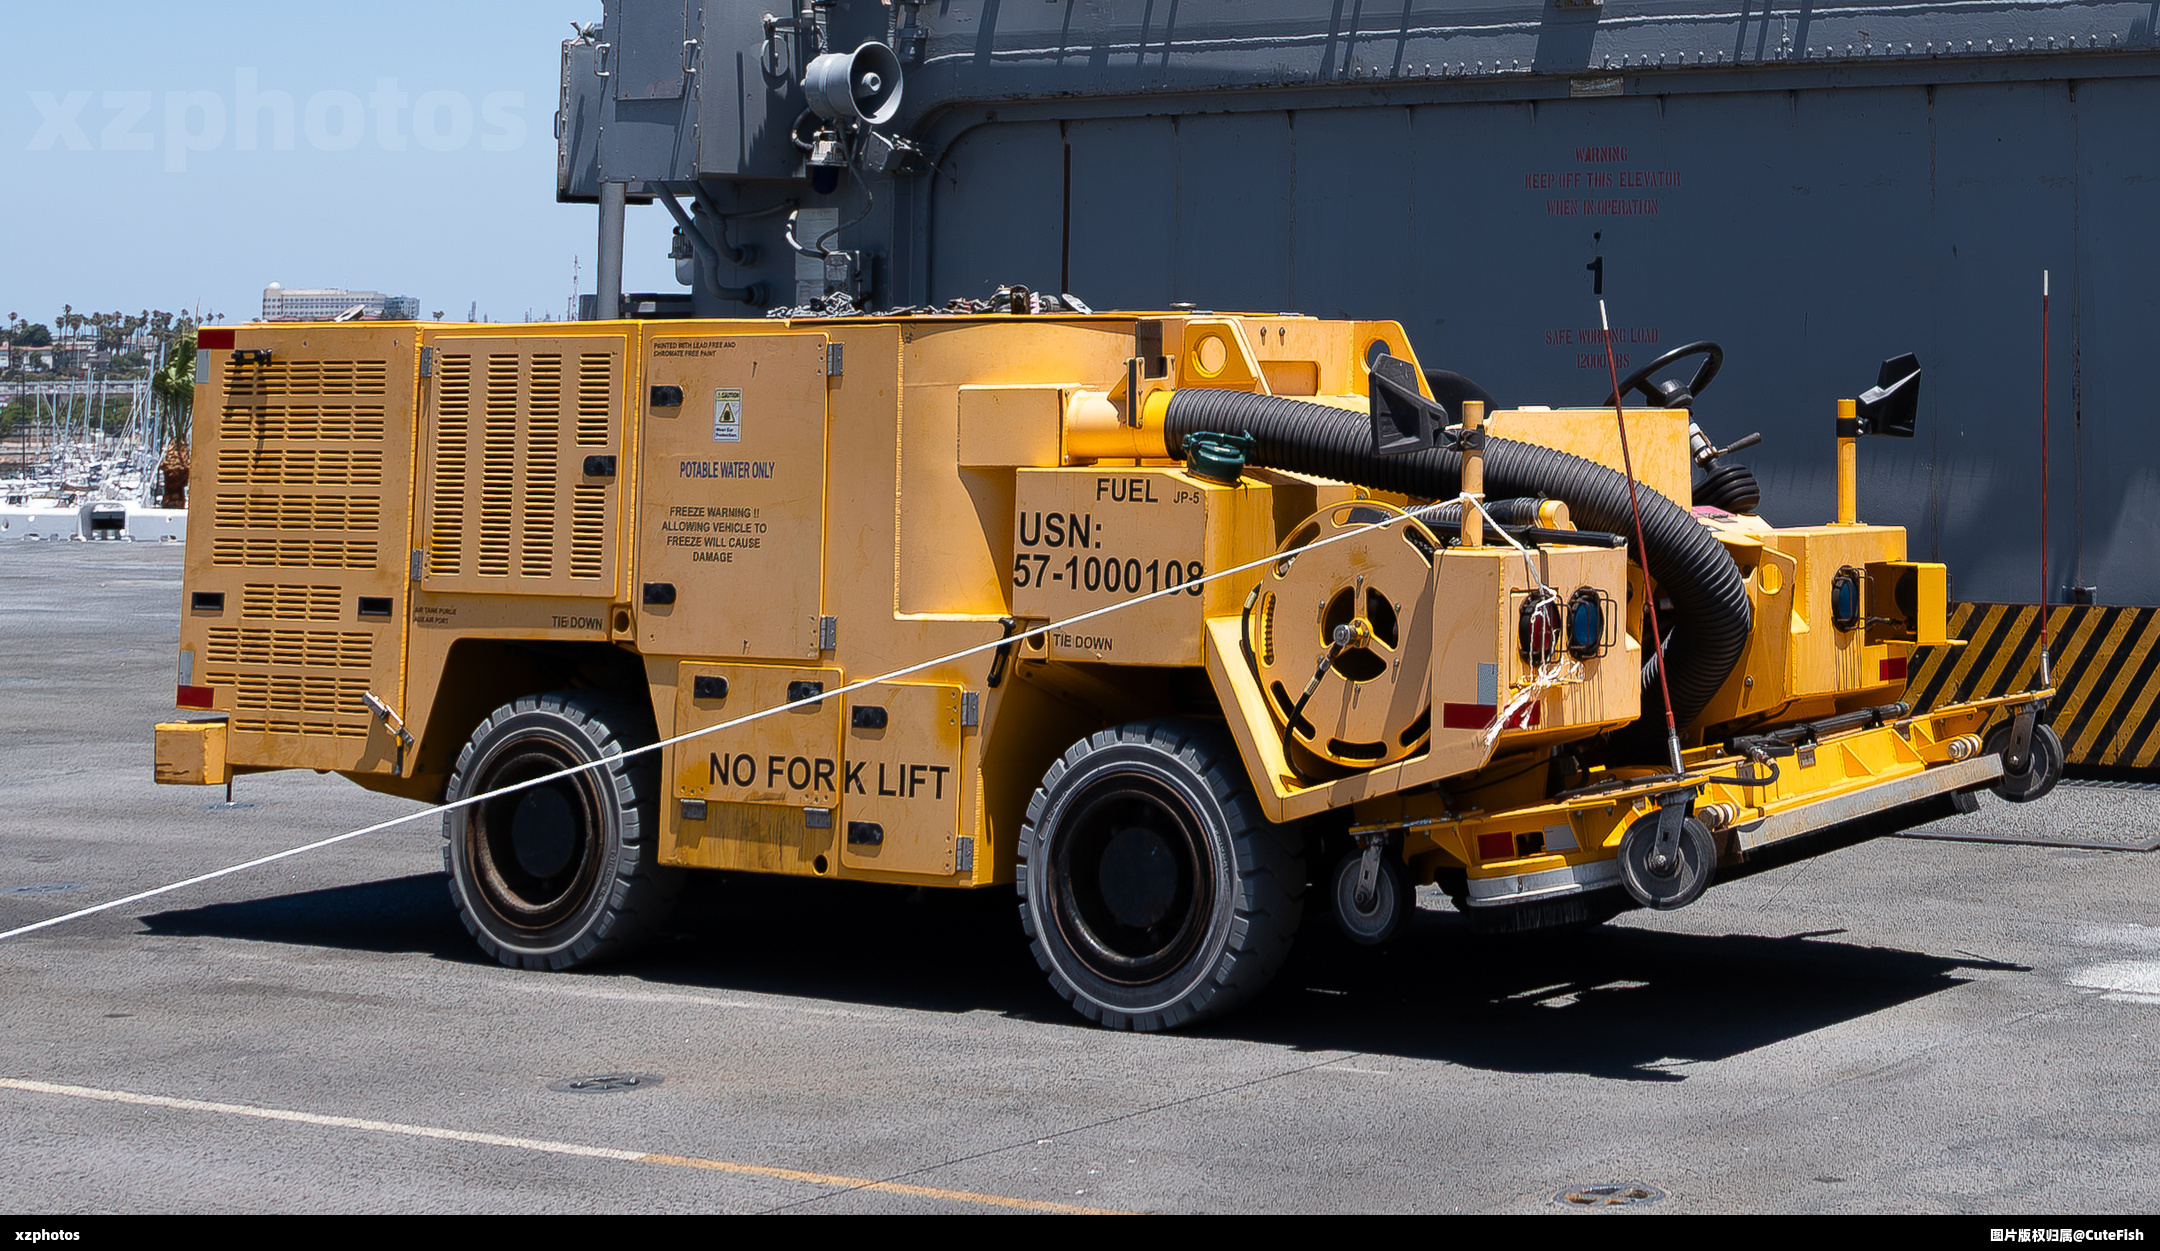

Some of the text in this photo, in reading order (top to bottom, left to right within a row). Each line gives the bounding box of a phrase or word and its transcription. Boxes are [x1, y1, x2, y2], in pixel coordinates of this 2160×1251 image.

[1575, 146, 1628, 163] WARNING
[1524, 170, 1682, 189] KEEP OFF THIS ELEVATOR
[1546, 199, 1659, 216] WHEN IN OPERATION
[1586, 256, 1603, 295] 1
[1545, 329, 1573, 346] SAFE
[1630, 327, 1659, 344] LOAD
[1608, 353, 1631, 369] BS
[680, 461, 775, 479] POTABLE WATER ONLY
[1096, 478, 1159, 503] FUEL
[1173, 491, 1200, 504] JP-5
[670, 506, 705, 517] FREEZE
[707, 507, 751, 518] WARNING
[661, 521, 767, 533] ALLOWING VEHICLE TO
[1019, 511, 1102, 549] USN:
[666, 536, 761, 548] FREEZE WILL CAUSE
[692, 551, 733, 562] DAMAGE
[1013, 553, 1205, 597] 57-1000108
[552, 615, 603, 630] TIE DOWN
[1053, 633, 1113, 651] TIE DOWN
[709, 752, 950, 799] NO FORK LIFT
